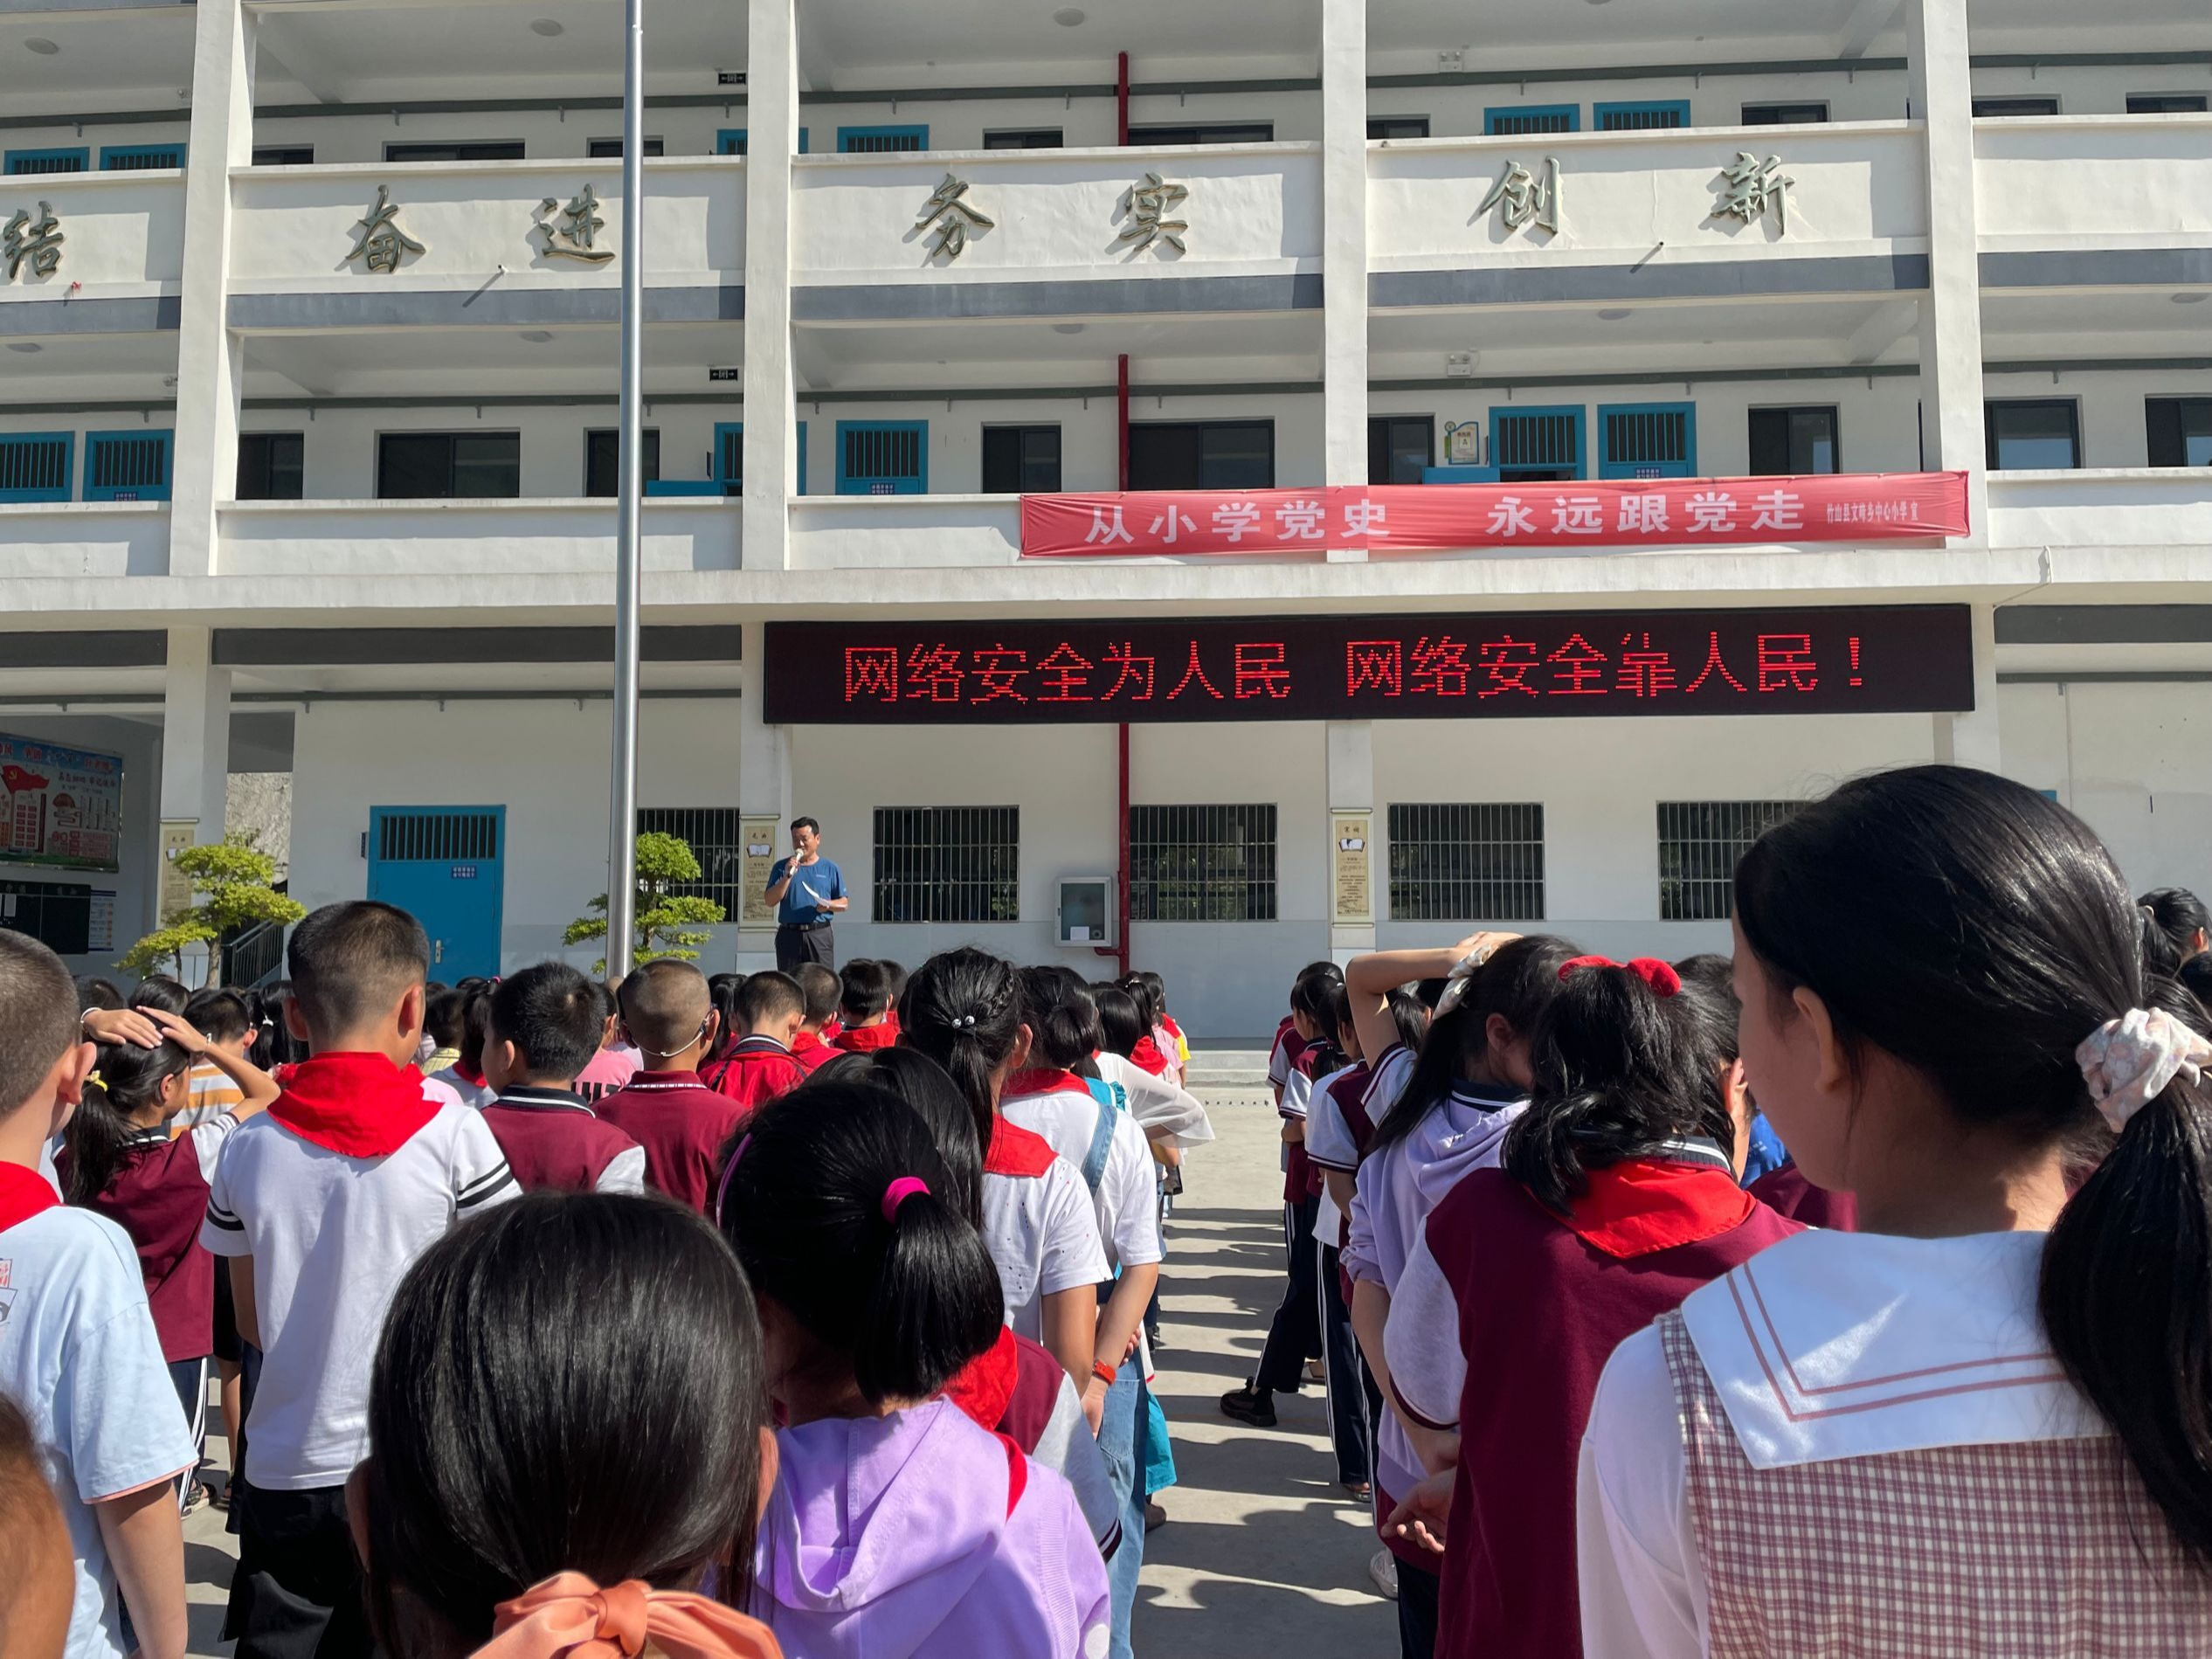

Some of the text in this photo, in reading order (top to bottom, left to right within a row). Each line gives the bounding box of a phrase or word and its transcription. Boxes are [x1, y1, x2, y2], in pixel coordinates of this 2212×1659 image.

[2, 200, 65, 280] 结
[1084, 489, 1805, 545] 从小学党史 永远跟党走
[845, 632, 1861, 704] 网络安全为人民 网络安全靠人民！
